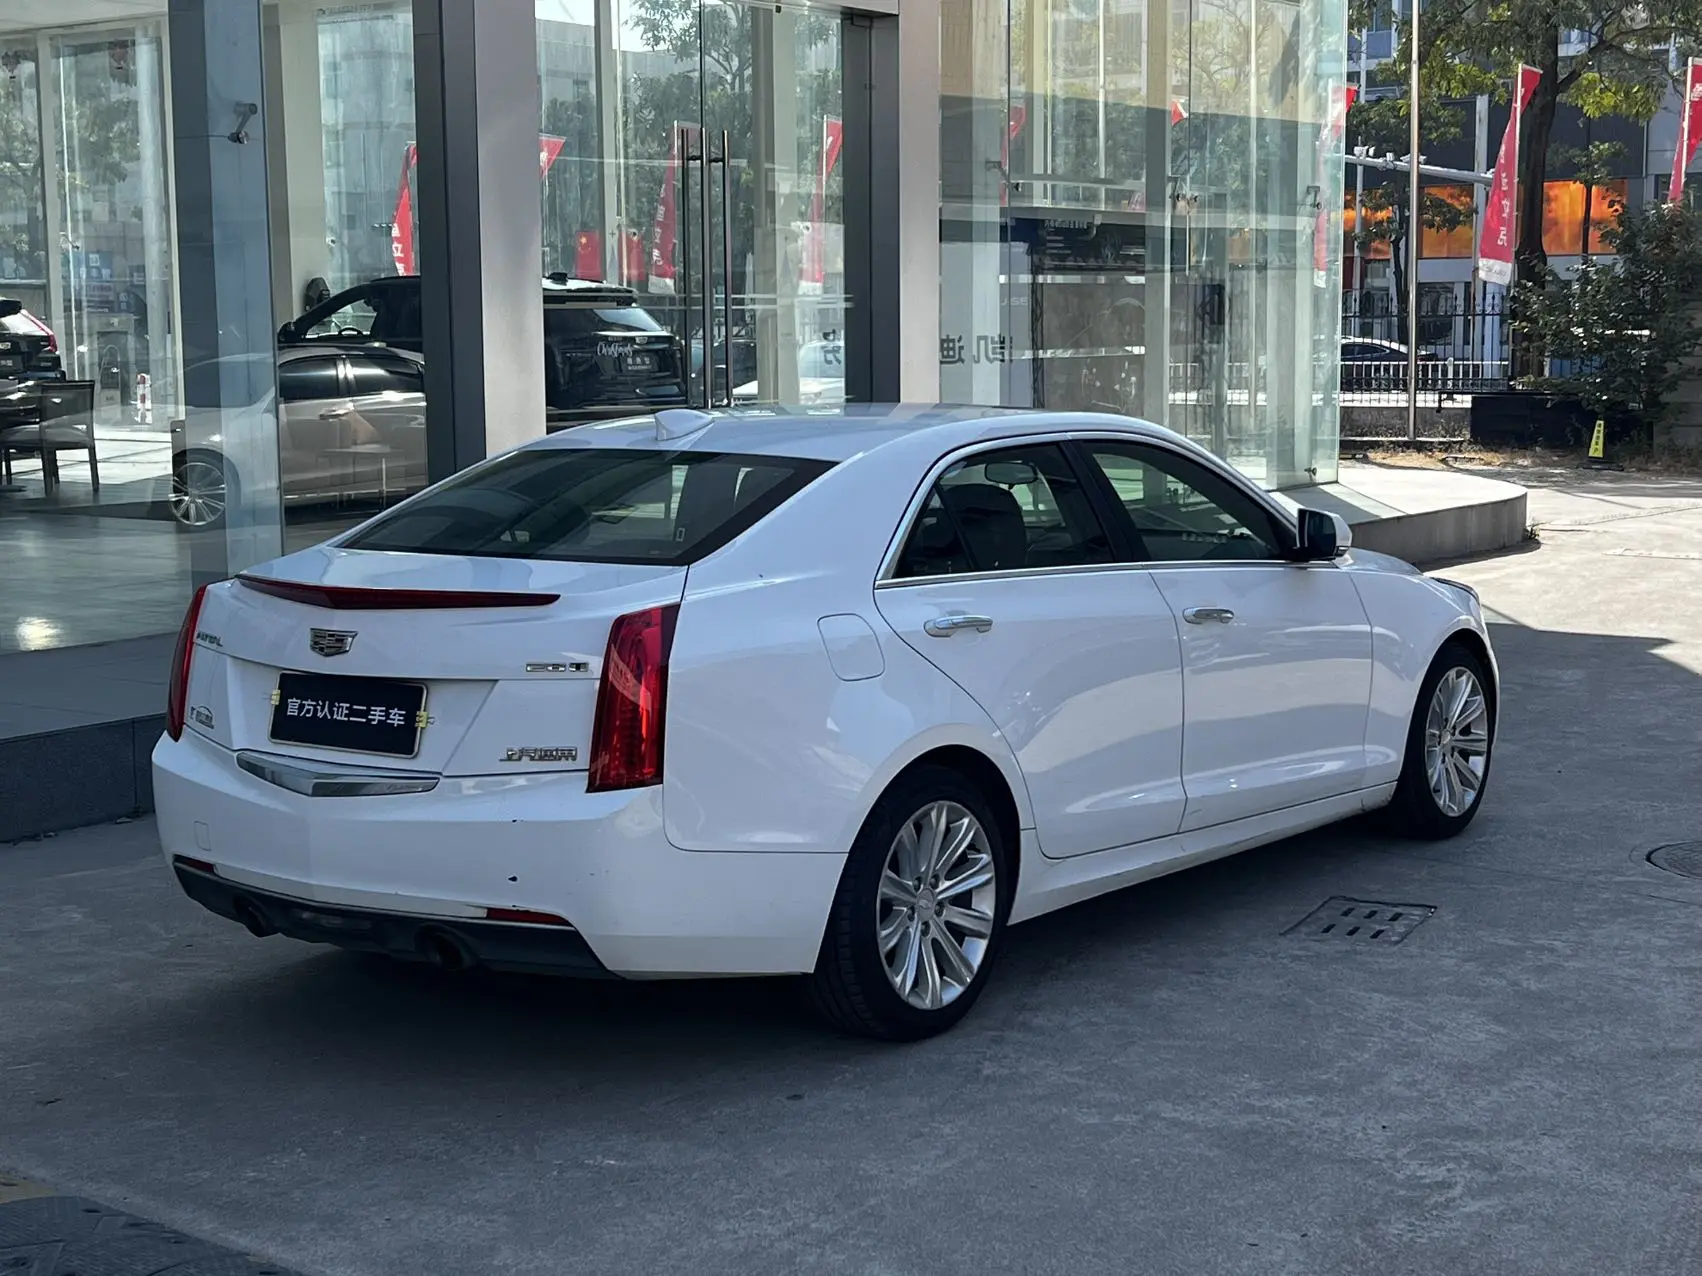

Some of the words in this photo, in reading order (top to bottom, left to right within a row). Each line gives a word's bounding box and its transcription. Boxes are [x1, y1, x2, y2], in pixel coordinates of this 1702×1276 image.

[286, 697, 406, 727] 官方认证二手车
